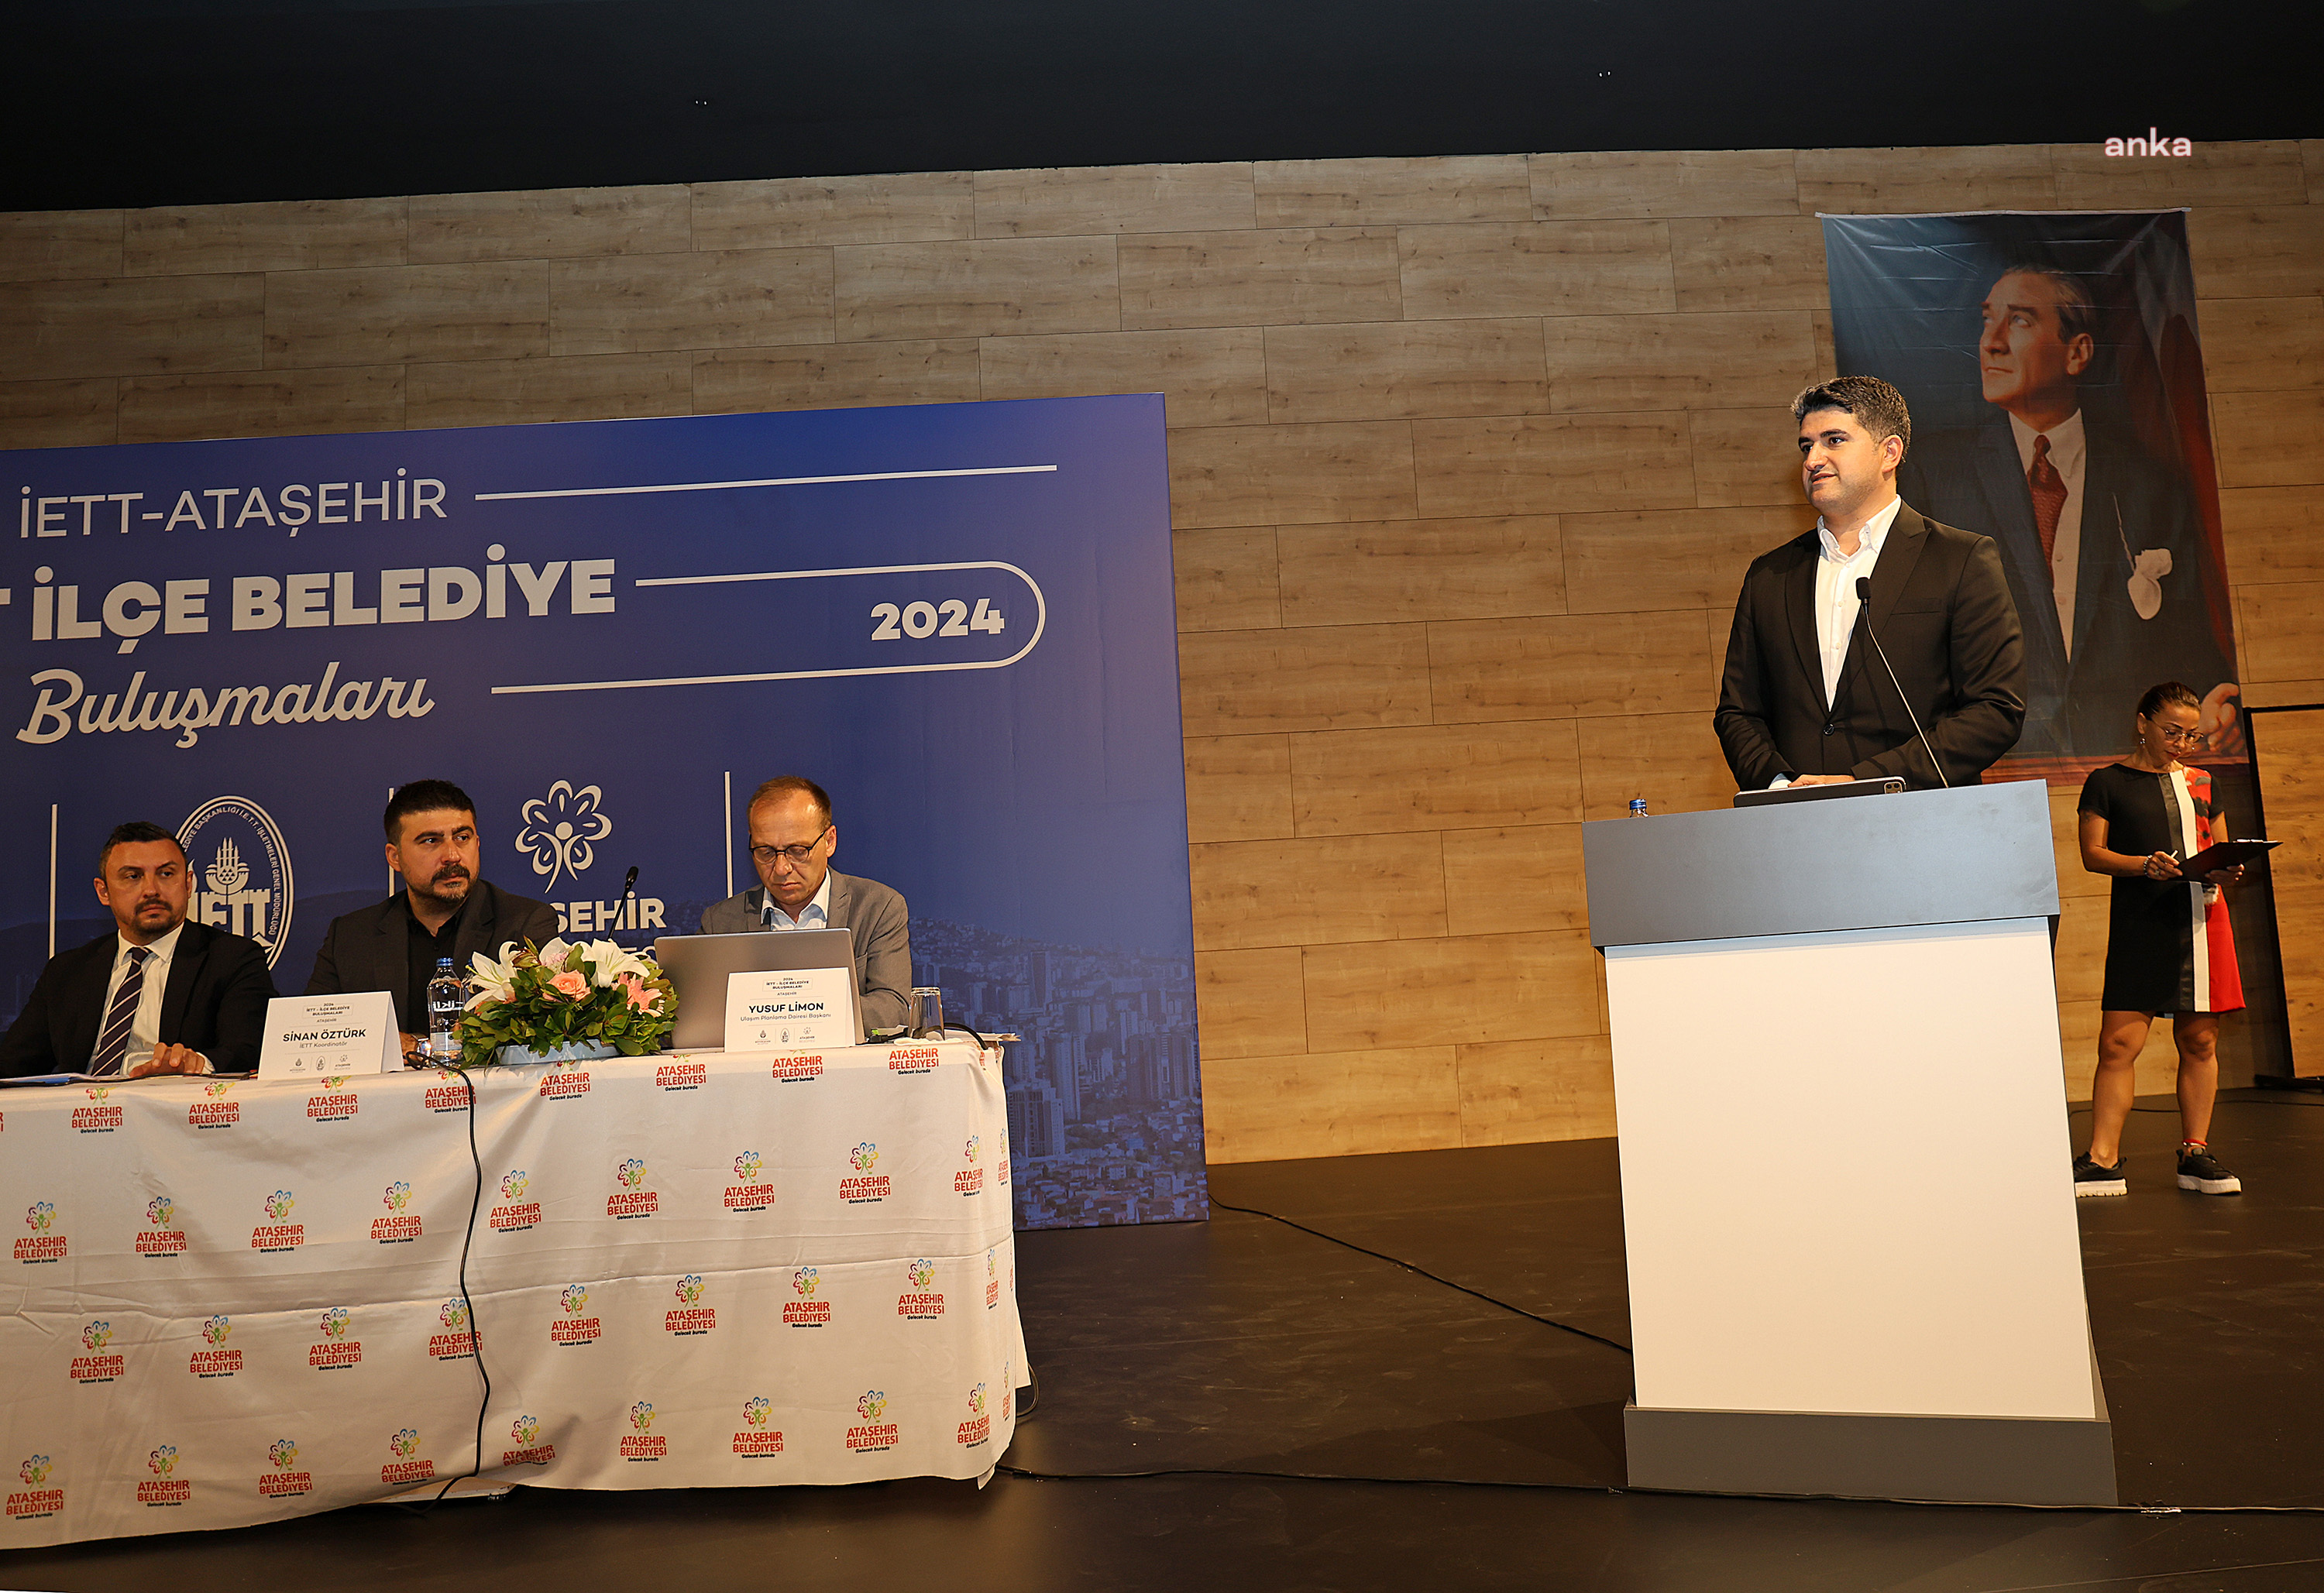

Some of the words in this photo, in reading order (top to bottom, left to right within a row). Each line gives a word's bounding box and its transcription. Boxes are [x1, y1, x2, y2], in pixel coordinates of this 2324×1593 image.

[20, 467, 447, 538] İETT-ATAŞEHİR
[32, 565, 210, 654] İLÇE
[232, 544, 616, 631] BELEDİYE
[870, 598, 1006, 640] 2024
[15, 661, 435, 749] Buluşmaları
[283, 1031, 318, 1042] SİNAN
[320, 1028, 367, 1040] ÖZTÜRK
[748, 1004, 786, 1014] YUSUF
[789, 1001, 824, 1012] LİMON
